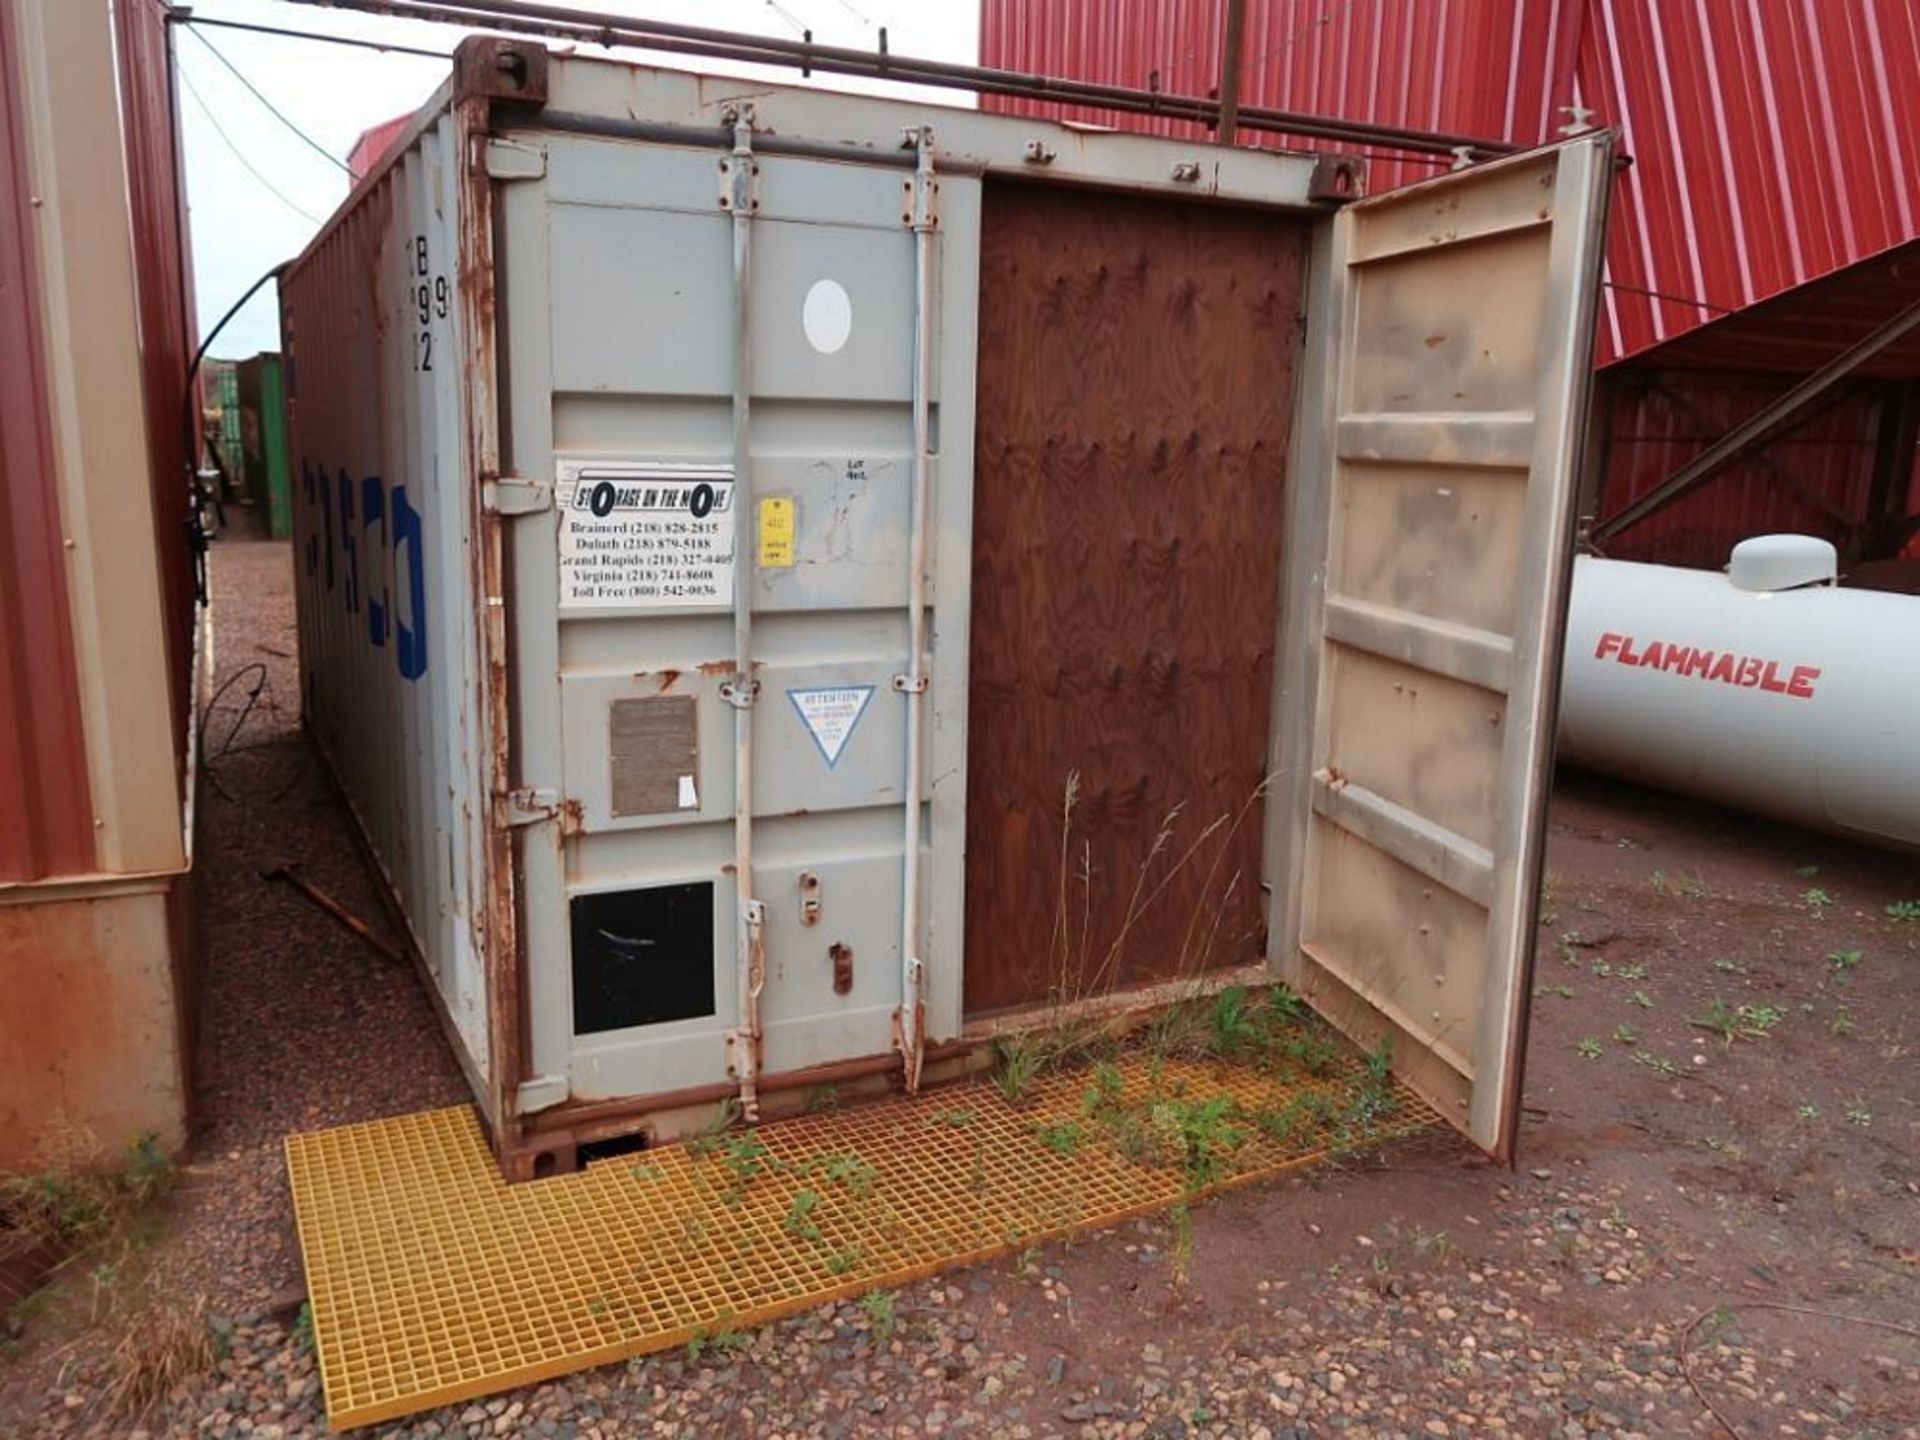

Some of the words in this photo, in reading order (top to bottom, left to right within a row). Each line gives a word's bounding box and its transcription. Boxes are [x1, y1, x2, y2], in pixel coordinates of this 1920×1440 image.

[643, 488, 659, 508] ON
[660, 488, 680, 508] THE
[679, 483, 727, 518] MOVE
[571, 522, 627, 534] Brainerd
[631, 523, 661, 535] (218)
[576, 538, 619, 549] Duluth
[624, 539, 654, 550] (218)
[600, 553, 644, 568] Rapids
[648, 554, 678, 567] (218)
[573, 570, 623, 584] Virginia
[627, 570, 658, 582] (218)
[573, 585, 594, 597] Toll
[598, 585, 626, 597] Free
[629, 585, 660, 598] (800)
[1594, 633, 1821, 698] FLAMMABLE
[805, 692, 859, 704] ATTENTION
